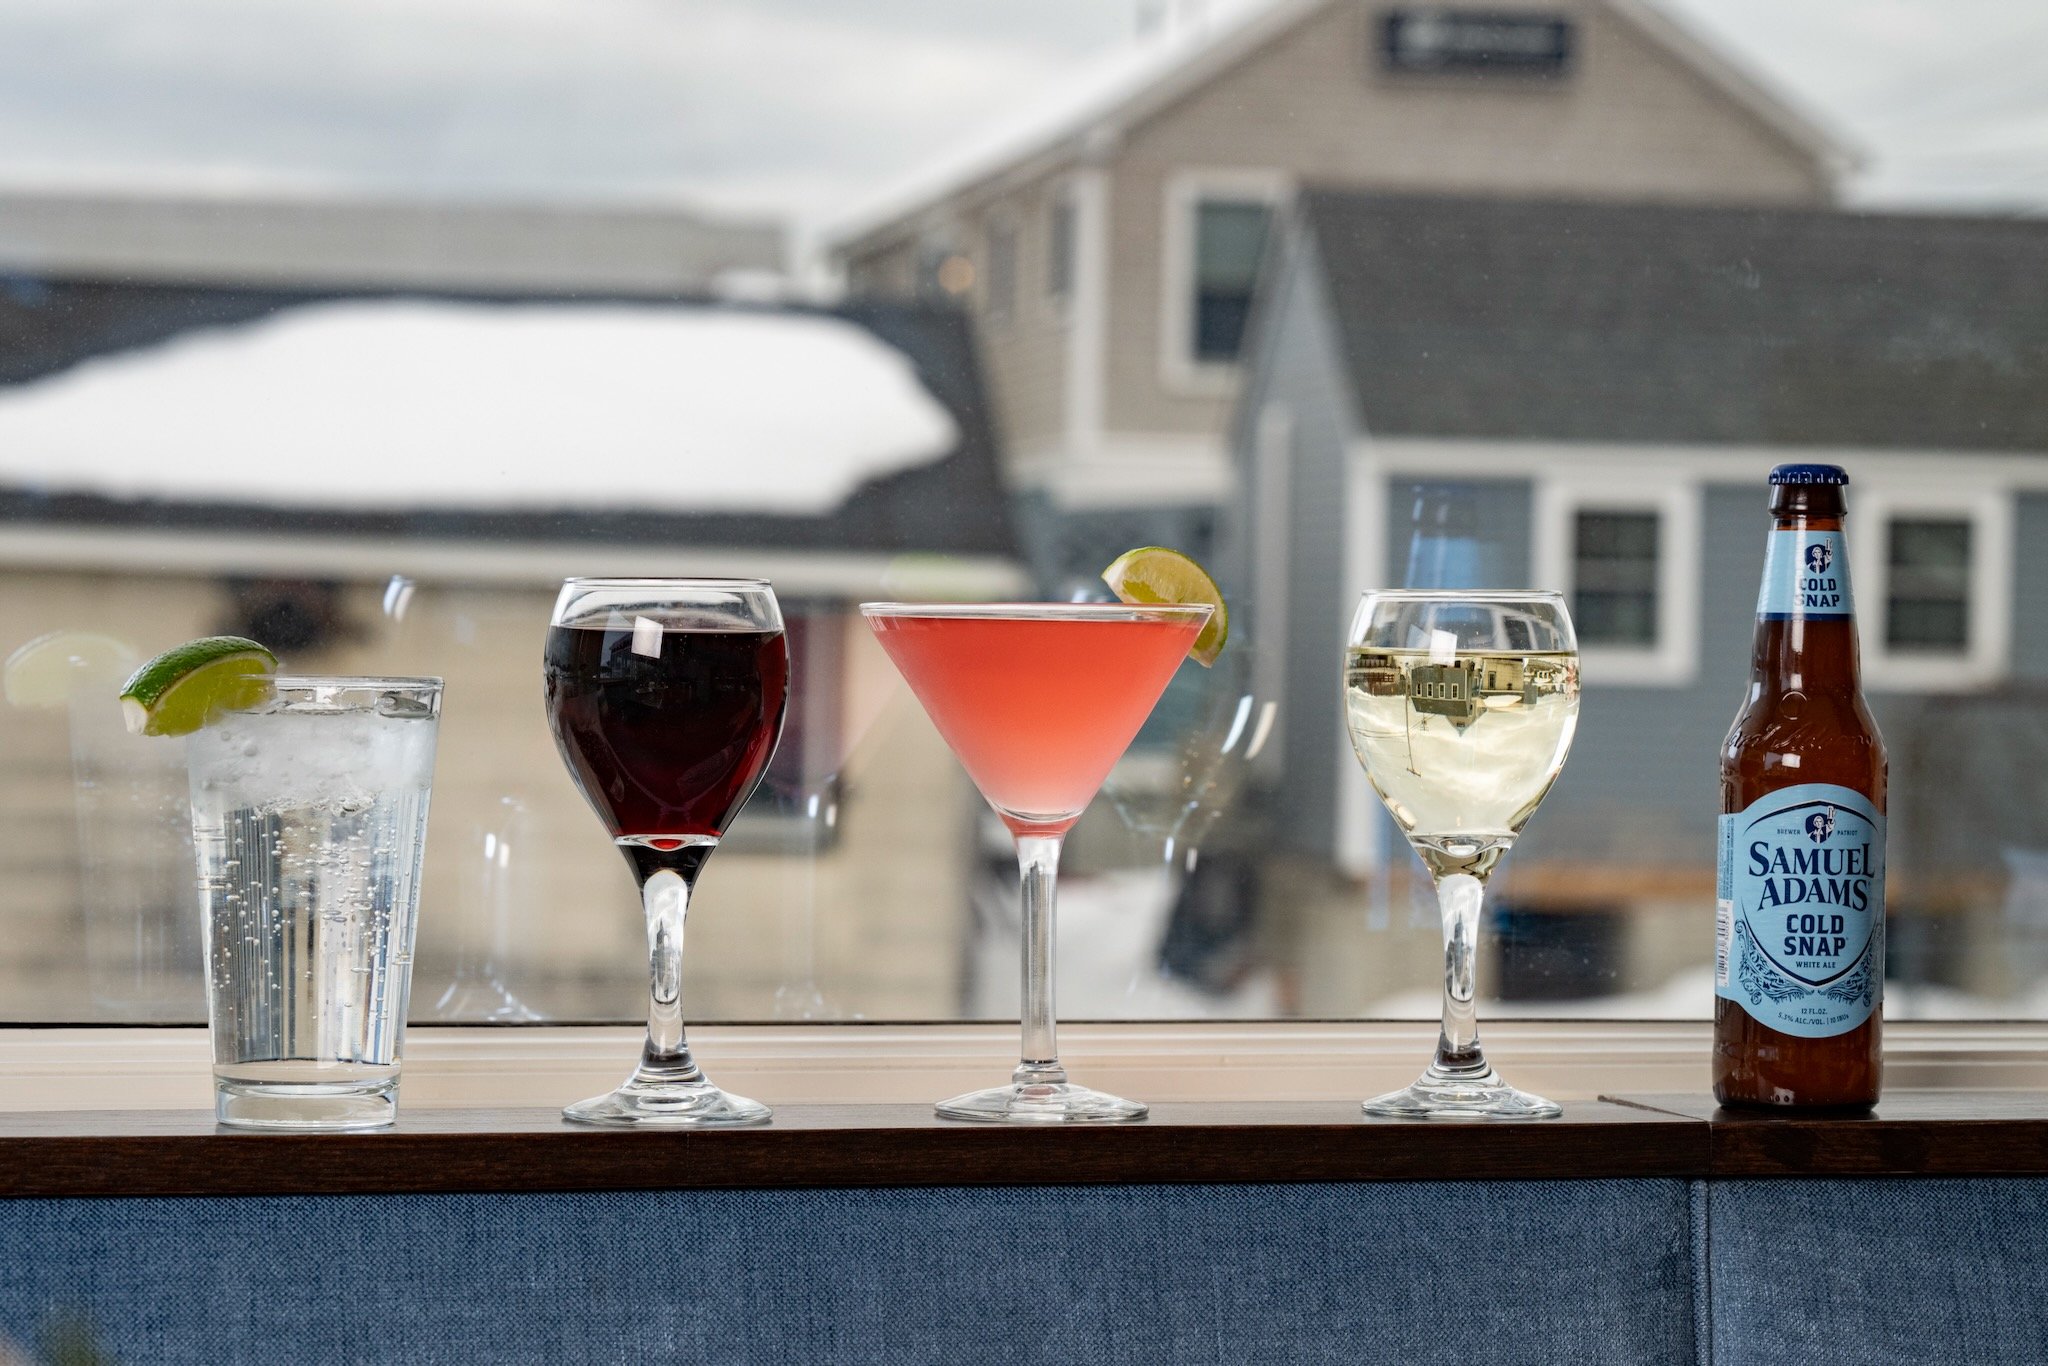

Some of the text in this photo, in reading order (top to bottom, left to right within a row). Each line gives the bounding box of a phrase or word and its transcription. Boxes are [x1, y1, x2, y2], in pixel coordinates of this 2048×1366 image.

[1799, 579, 1837, 591] COLD
[1749, 841, 1875, 879] SAMUEL
[1757, 877, 1868, 912] ADAMS
[1786, 914, 1844, 934] COLD
[1783, 937, 1846, 957] SNAP
[1795, 961, 1836, 969] WHITE ALE
